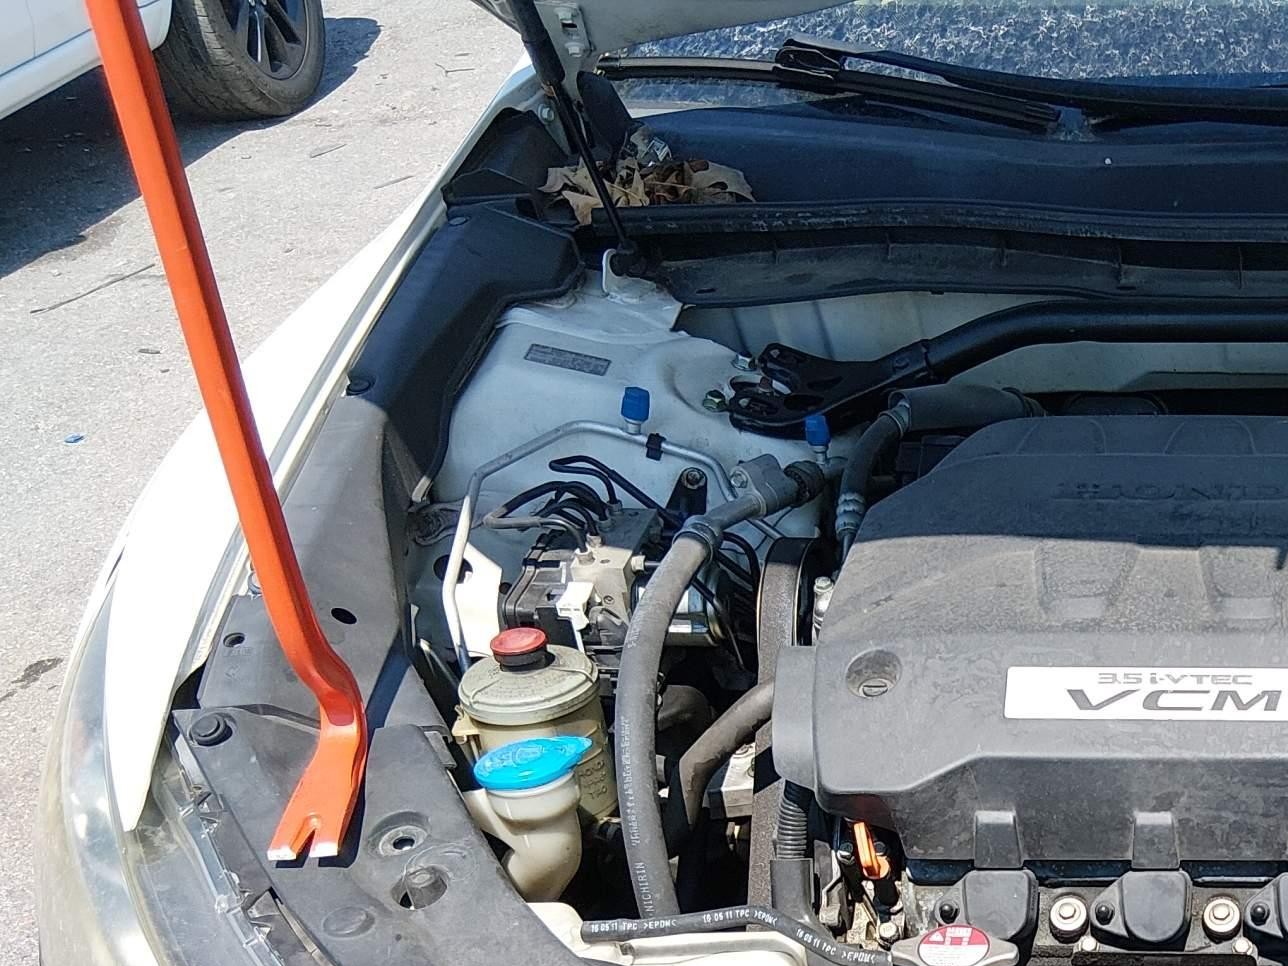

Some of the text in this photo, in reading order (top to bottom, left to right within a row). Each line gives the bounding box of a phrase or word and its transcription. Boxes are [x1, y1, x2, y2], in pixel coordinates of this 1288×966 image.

[1150, 672, 1253, 685] i-VTEC
[1066, 688, 1283, 711] VCM
[735, 908, 750, 919] TPC
[622, 921, 638, 931] TPC
[821, 941, 837, 956] TPC
